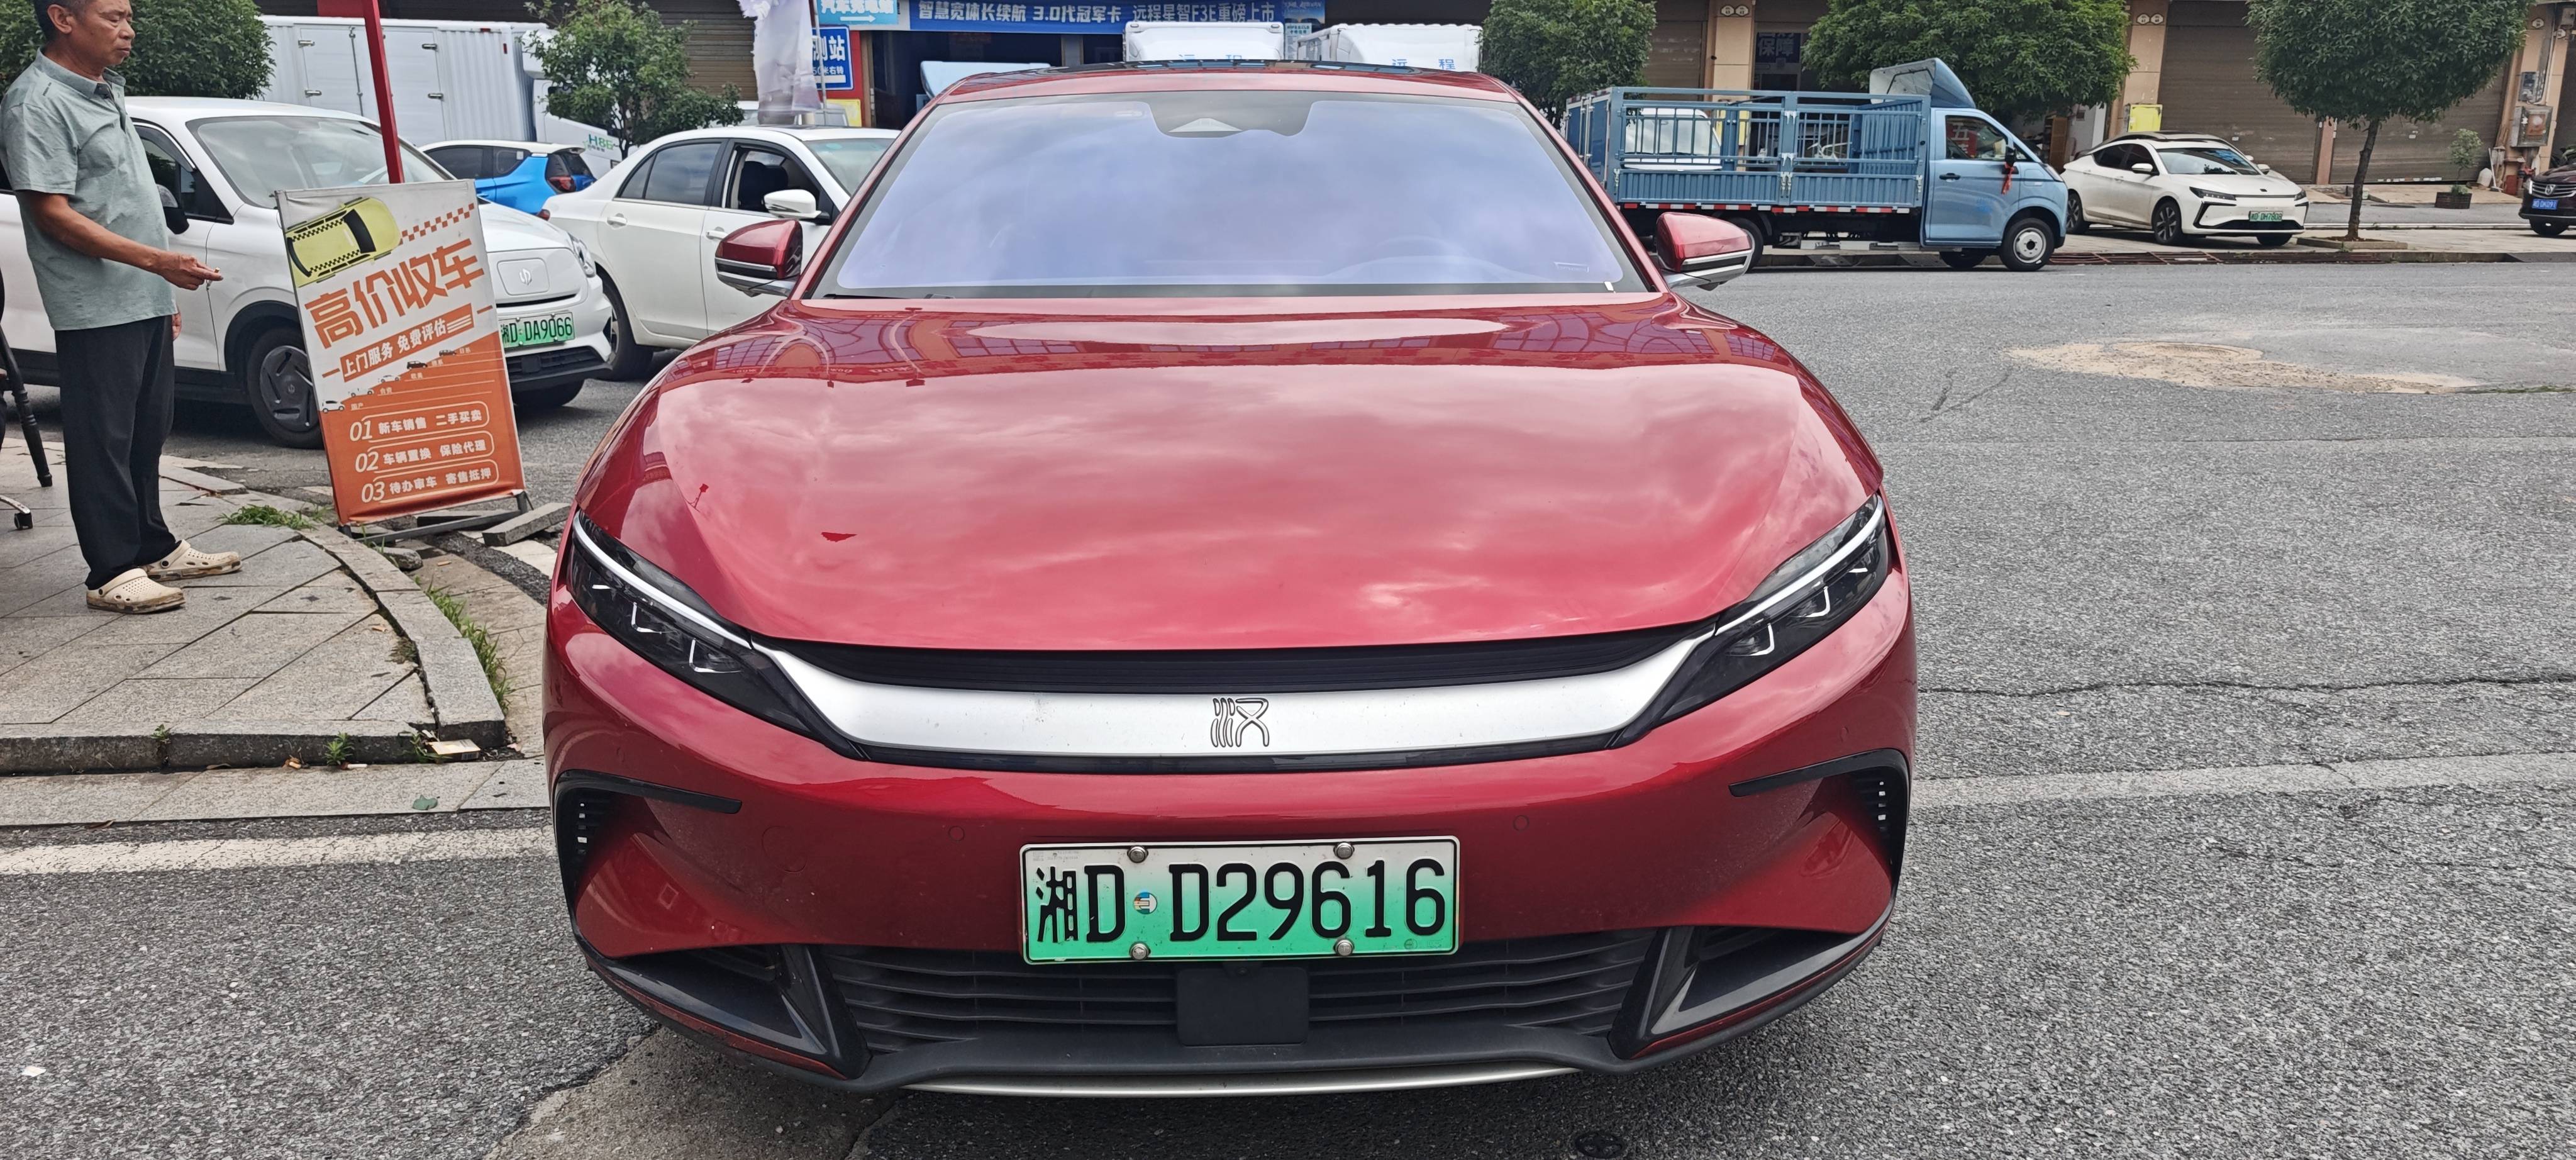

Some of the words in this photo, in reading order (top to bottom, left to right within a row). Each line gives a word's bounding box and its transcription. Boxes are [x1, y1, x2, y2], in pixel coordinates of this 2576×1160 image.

[919, 1, 1026, 22] 智慧宽体长续航
[1033, 5, 1121, 23] 3.0代冠军卡
[304, 238, 484, 349] 高价收车
[344, 342, 393, 377] 上门服务
[397, 318, 447, 354] 免费评估
[350, 420, 372, 442] 01
[379, 416, 426, 435] 新车销售
[436, 410, 482, 425] 二手买卖
[355, 451, 379, 472] 02
[383, 447, 431, 465] 车辆置换
[440, 439, 487, 457] 保险代理
[362, 481, 385, 503] 03
[445, 467, 491, 484] 寄售抵押
[1169, 859, 1445, 942] D29616
